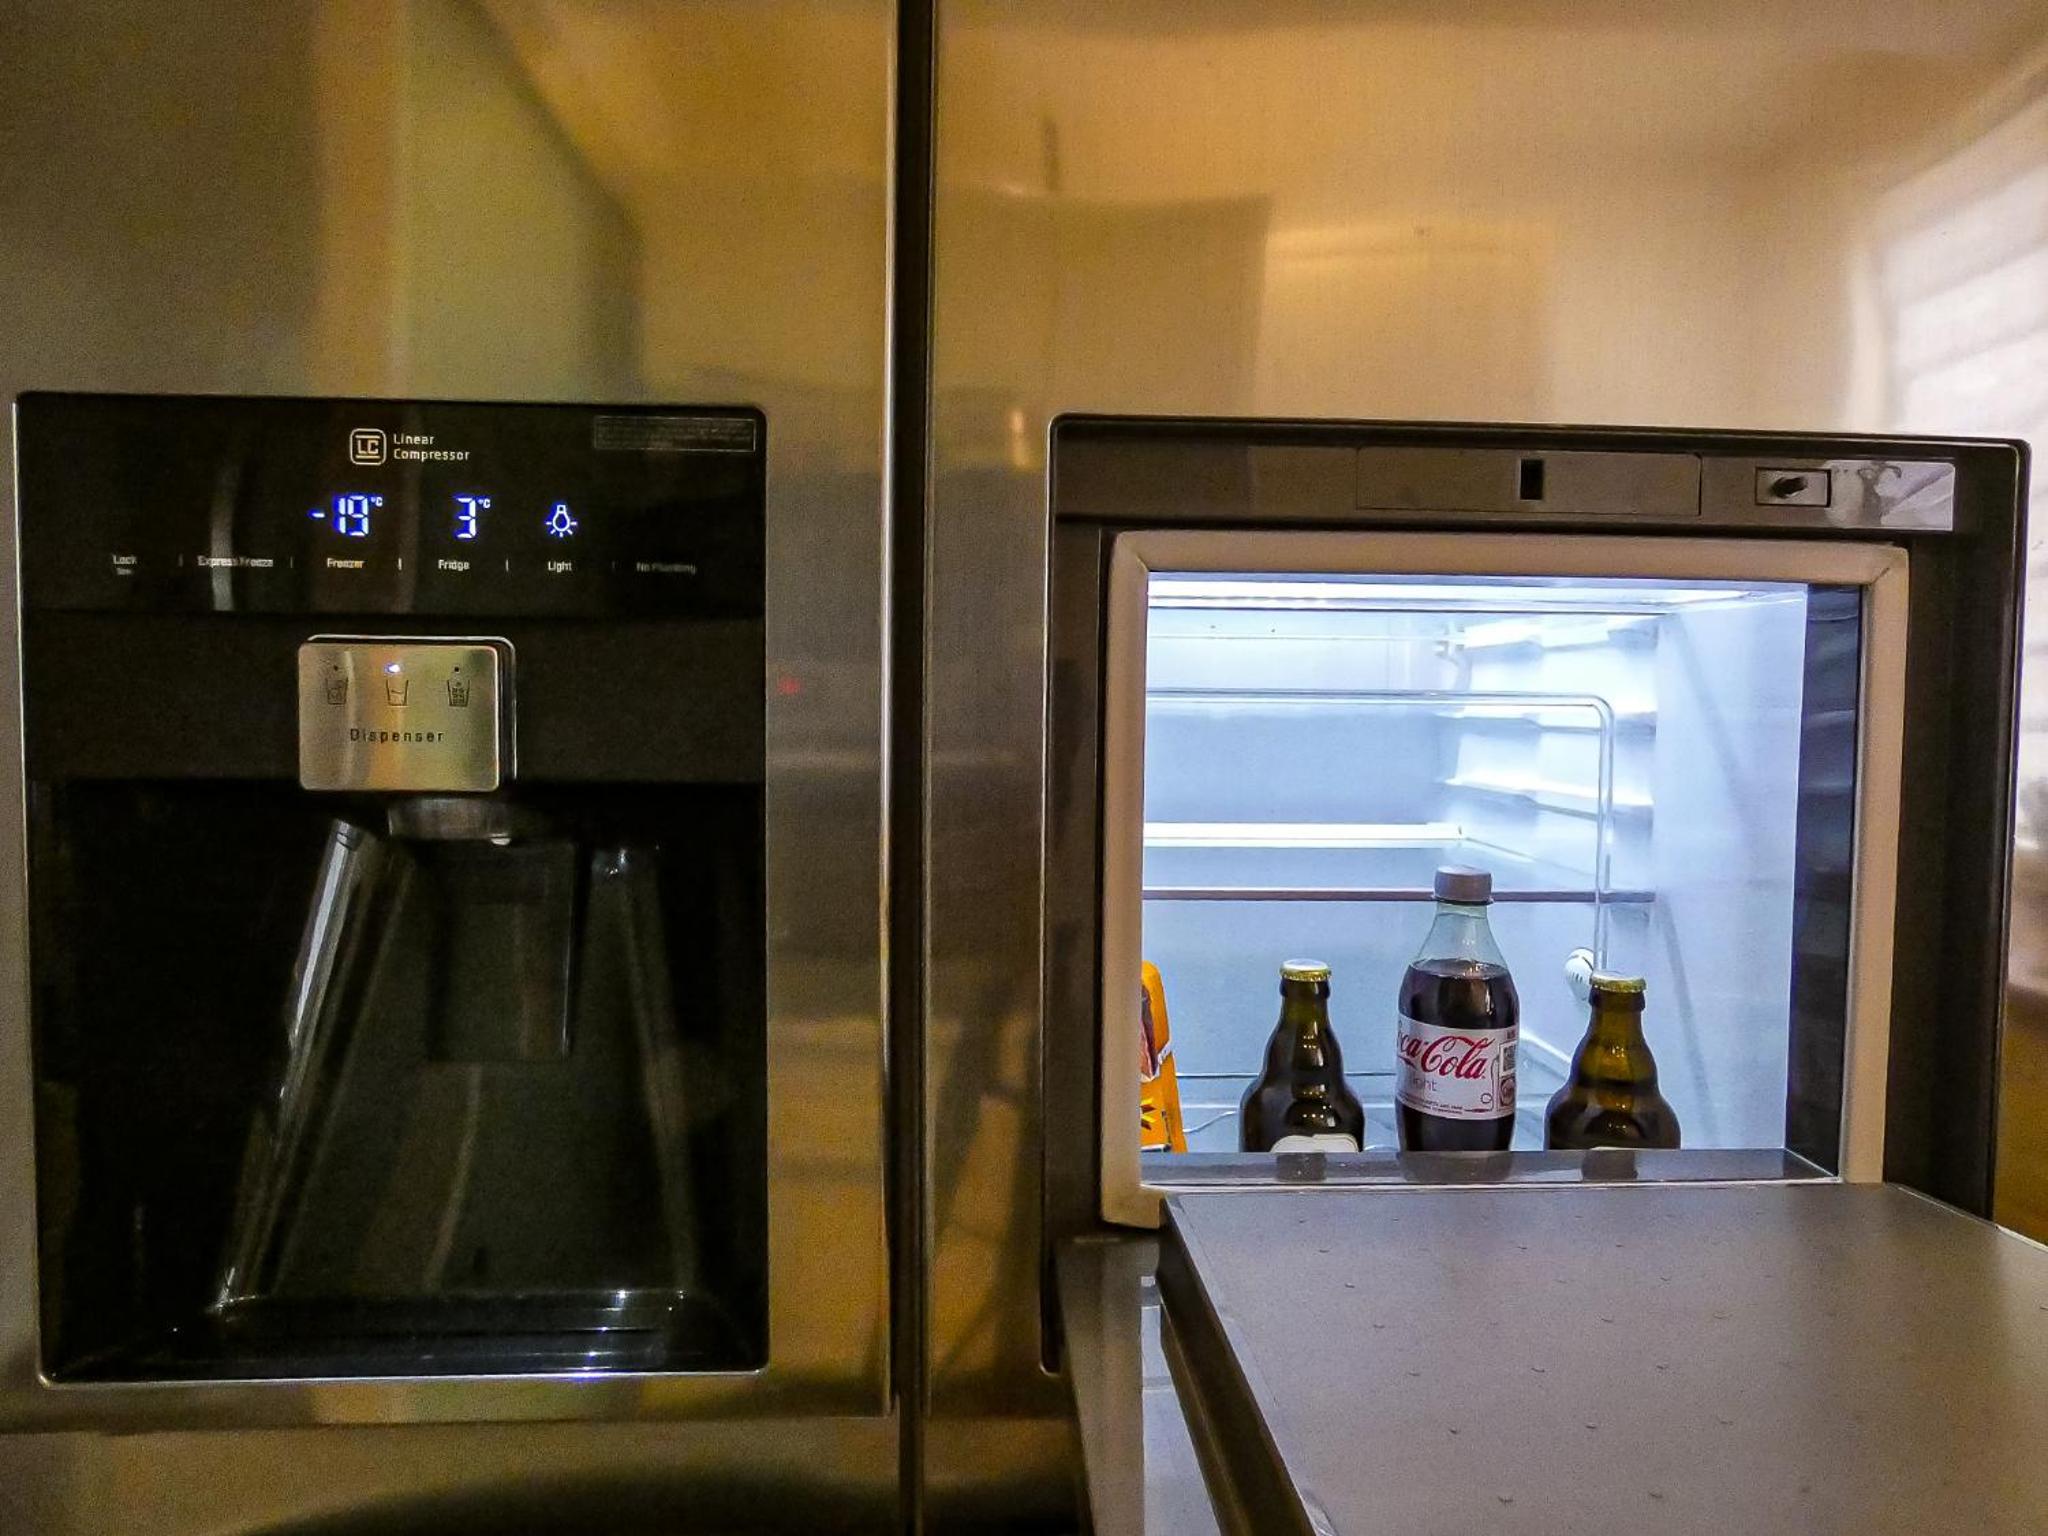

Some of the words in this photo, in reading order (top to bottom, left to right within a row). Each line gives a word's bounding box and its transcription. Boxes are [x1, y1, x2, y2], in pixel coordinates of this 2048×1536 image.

[393, 433, 435, 445] Linear
[393, 448, 470, 462] Compressor
[327, 557, 365, 569] Freezer
[438, 559, 470, 572] Fridge
[548, 561, 572, 573] Light
[350, 728, 444, 744] Dispenser
